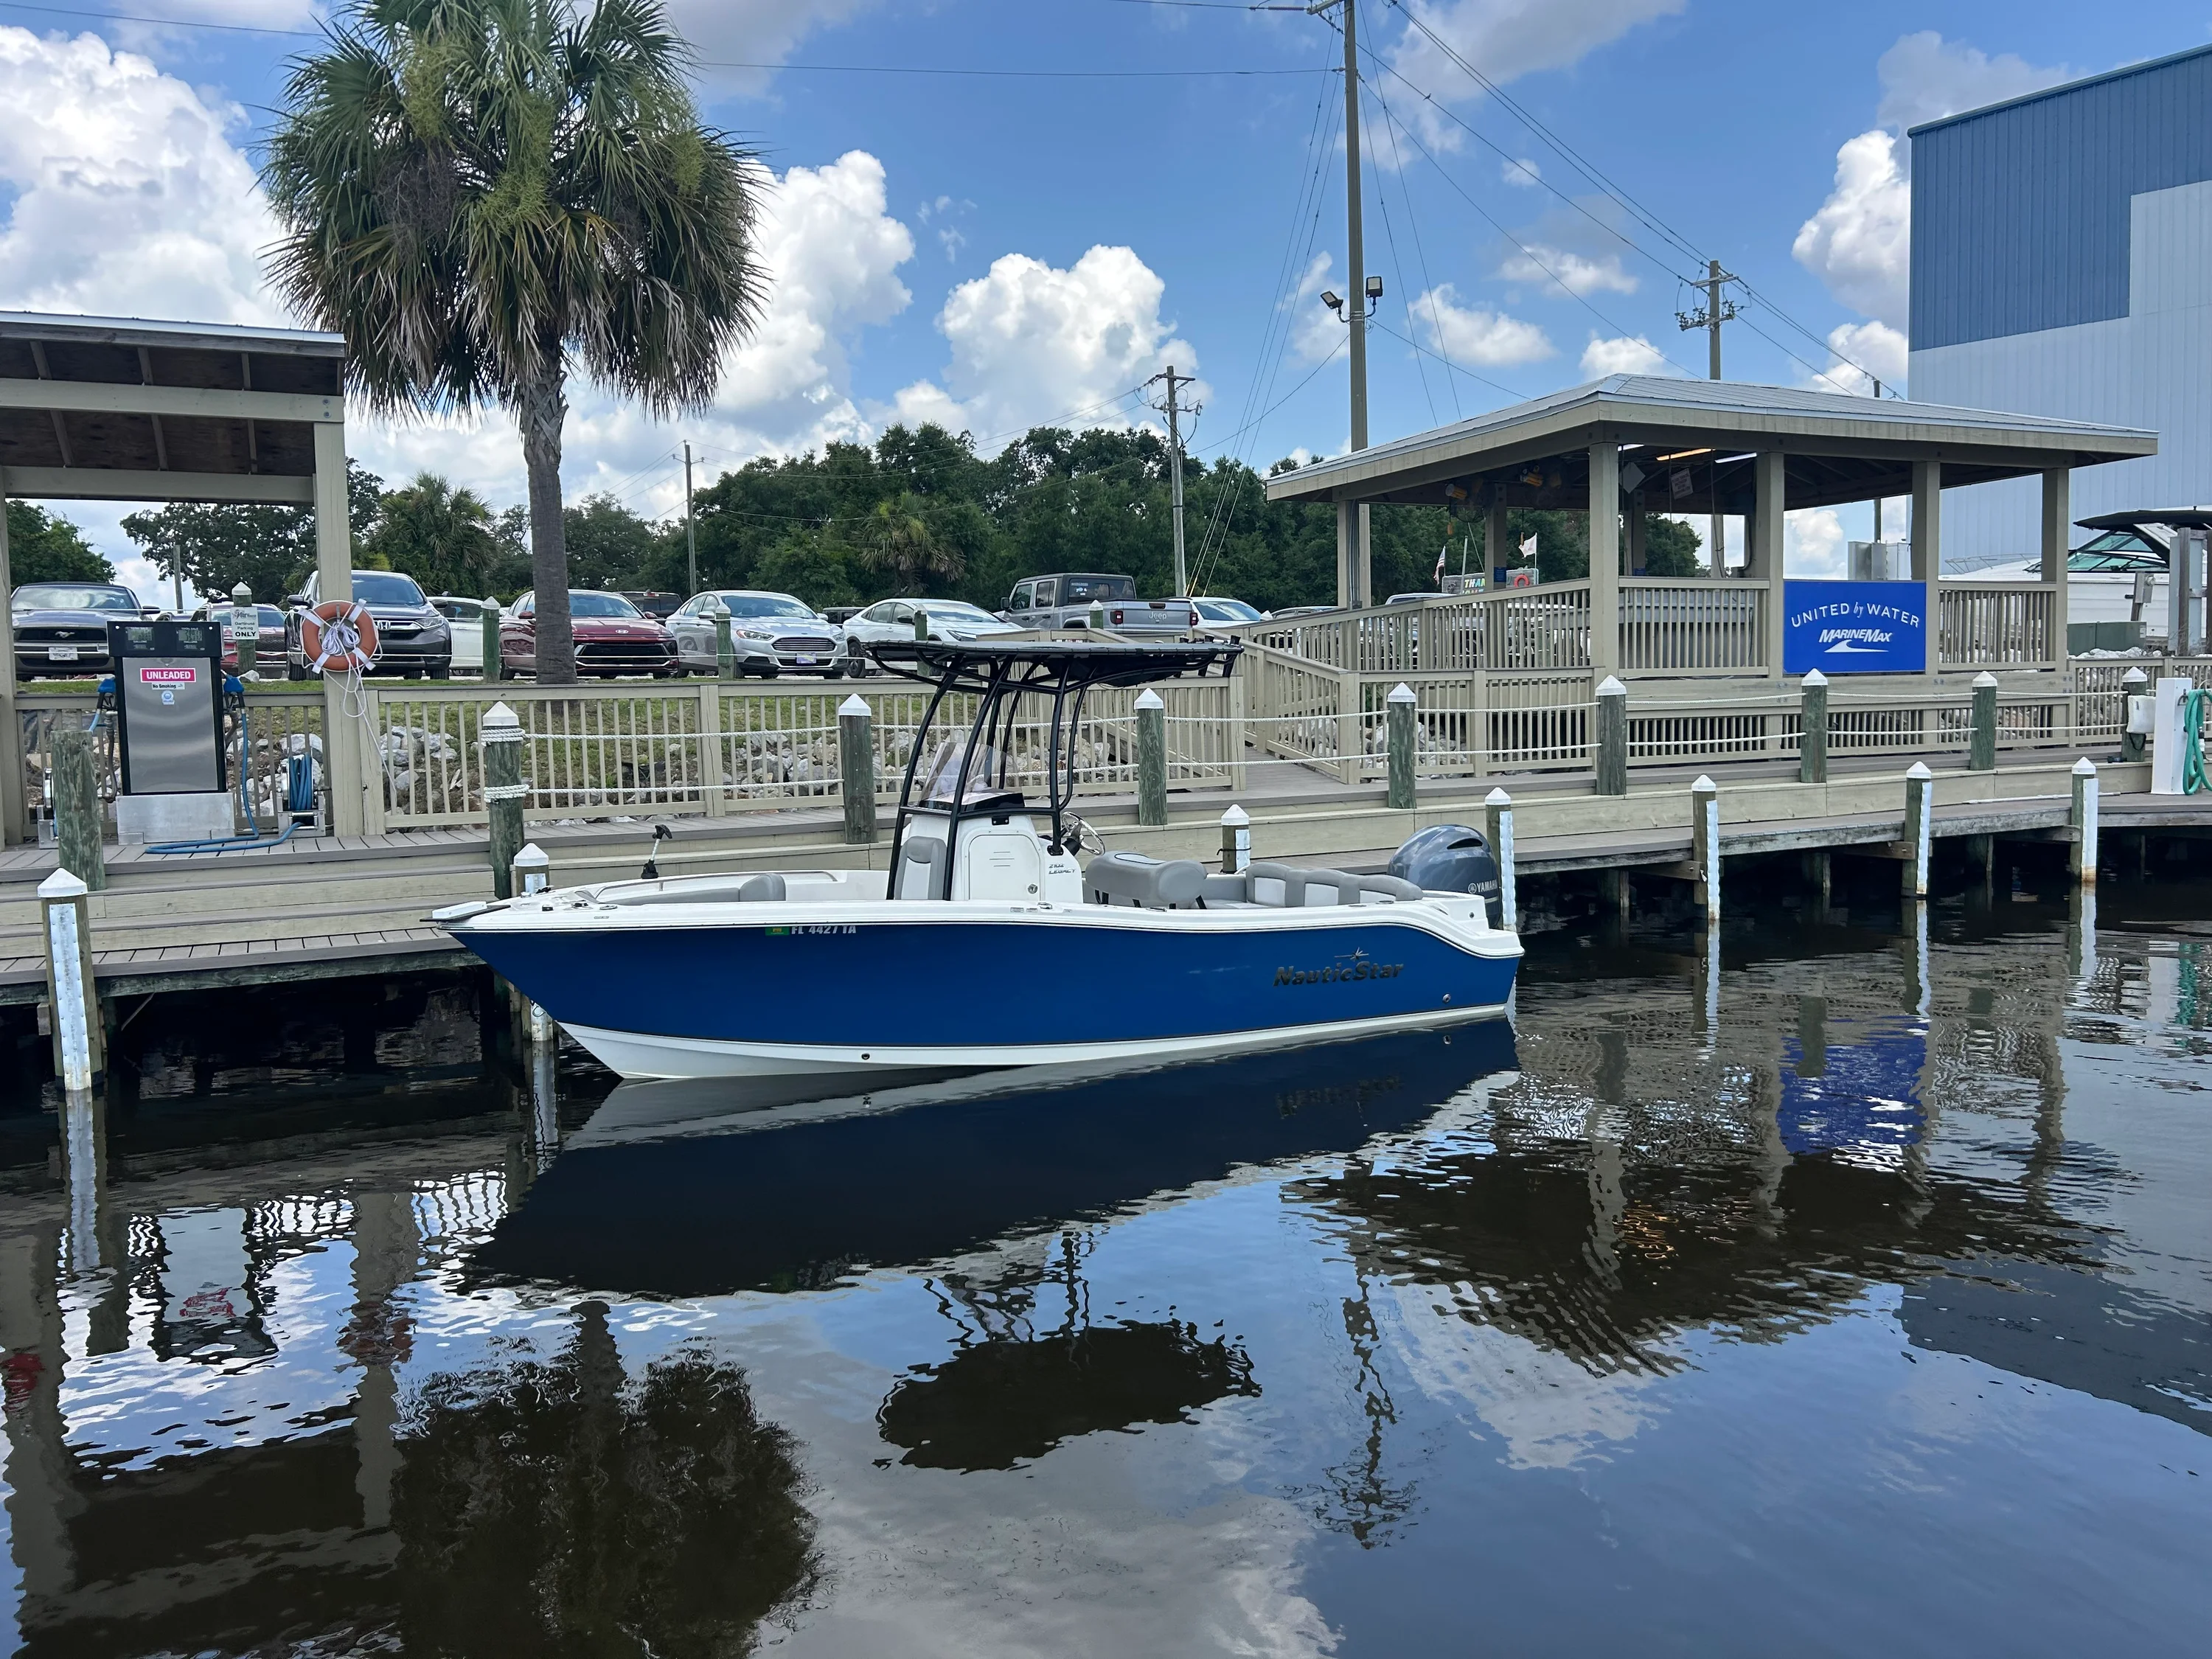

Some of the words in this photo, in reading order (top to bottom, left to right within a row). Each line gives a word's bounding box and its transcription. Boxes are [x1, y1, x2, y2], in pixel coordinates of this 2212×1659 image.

[1464, 578, 1486, 588] THAN
[1148, 611, 1166, 619] Jeep
[1791, 603, 1849, 627] UNITED
[1853, 602, 1863, 618] by
[1867, 603, 1919, 627] WATER
[146, 671, 191, 679] UNLEADED
[1476, 879, 1498, 892] YAMAHA
[791, 926, 804, 934] FL
[808, 926, 838, 934] 4427
[842, 925, 856, 933] TA
[1273, 961, 1404, 987] NauticStar
